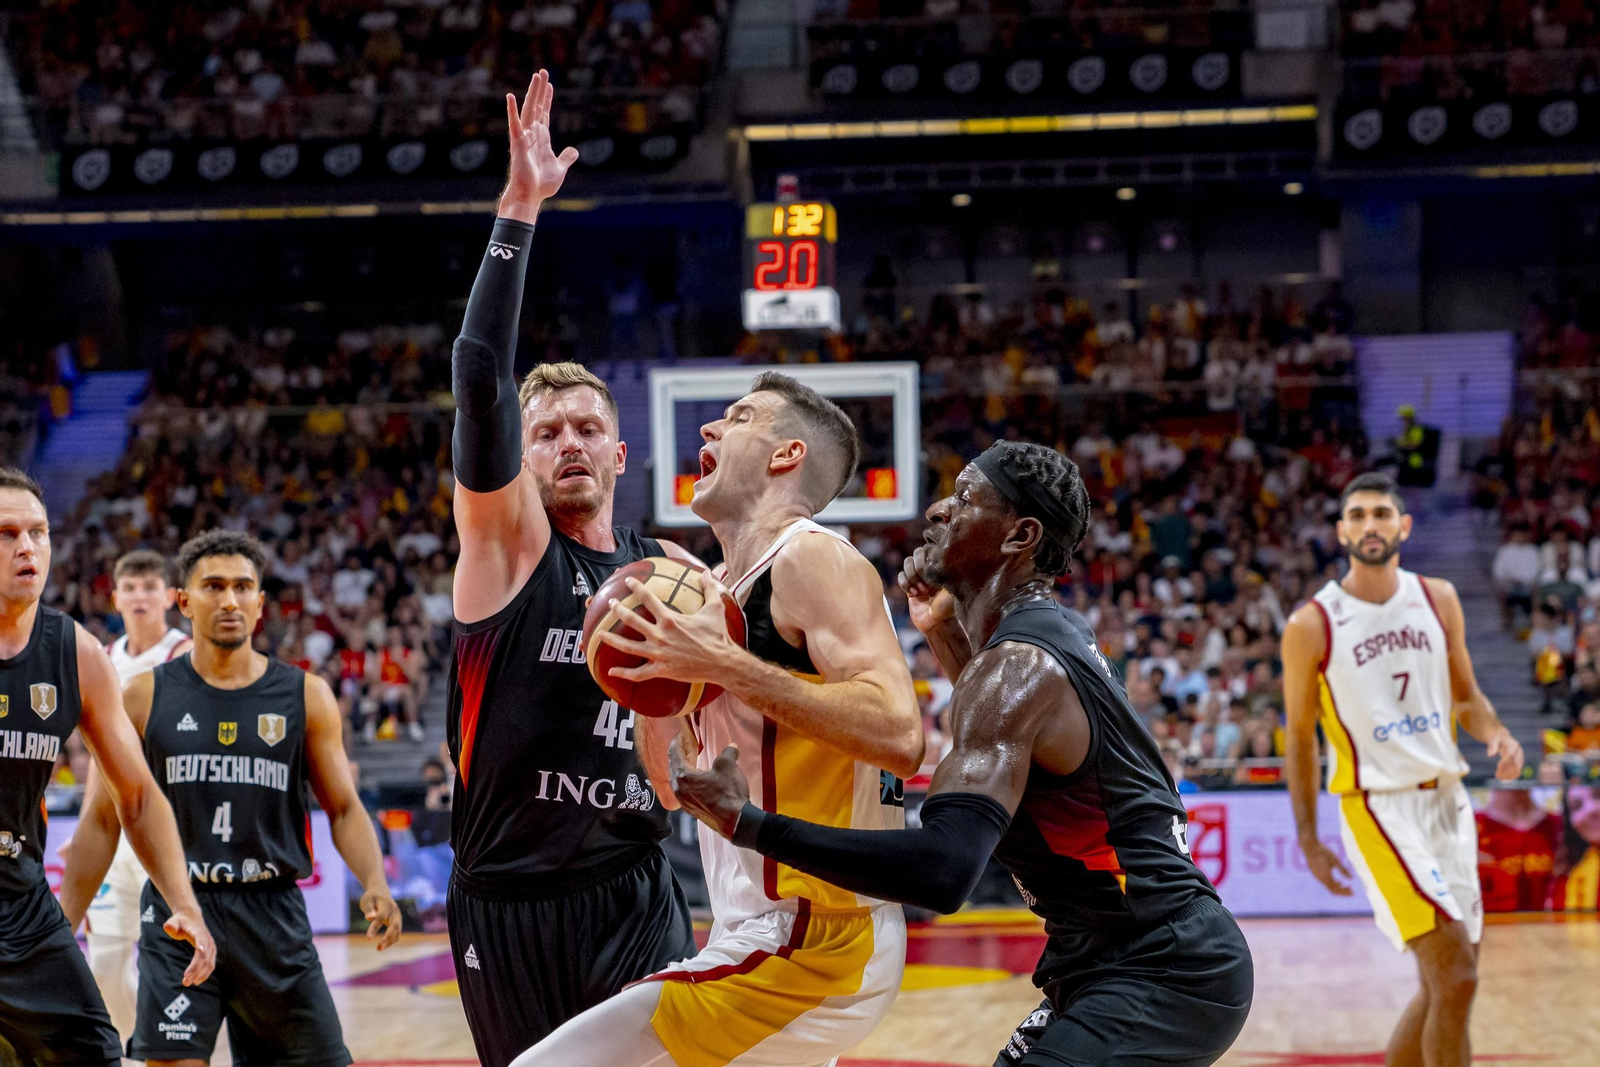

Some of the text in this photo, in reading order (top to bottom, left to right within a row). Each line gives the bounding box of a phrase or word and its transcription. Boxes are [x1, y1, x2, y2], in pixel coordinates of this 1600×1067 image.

[1353, 624, 1432, 667] ESPAÑA
[1392, 671, 1410, 702] 7
[593, 699, 636, 750] 42
[166, 754, 289, 792] DEUTSCHLAND
[535, 770, 616, 809] ING
[211, 801, 233, 843] 4
[187, 861, 235, 884] NG
[158, 1021, 198, 1033] Domino's
[165, 1031, 192, 1041] Pizza
